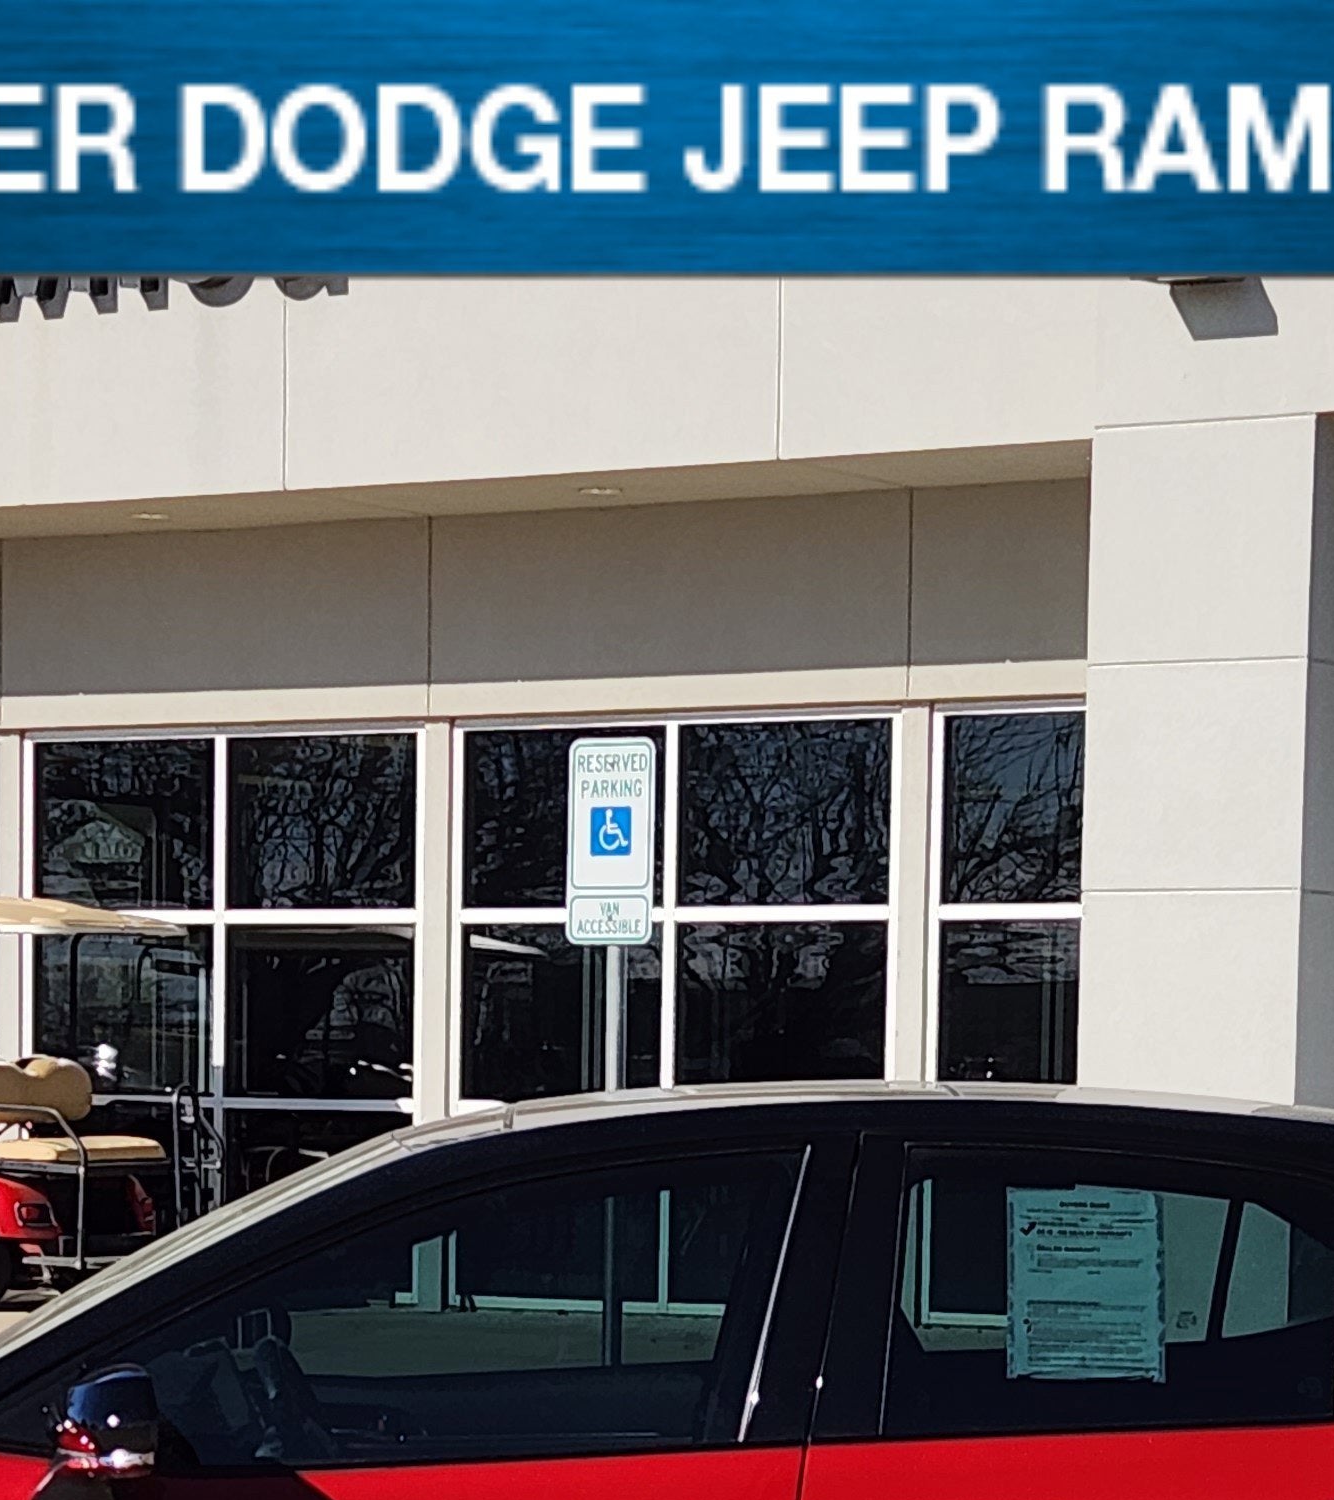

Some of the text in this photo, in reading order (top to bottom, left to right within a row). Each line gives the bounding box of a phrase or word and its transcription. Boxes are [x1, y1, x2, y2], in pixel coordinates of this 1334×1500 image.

[577, 753, 648, 773] RESERVED
[581, 779, 643, 798] PARKING
[599, 902, 620, 916] VAN
[577, 919, 642, 934] ACCESSIBLE
